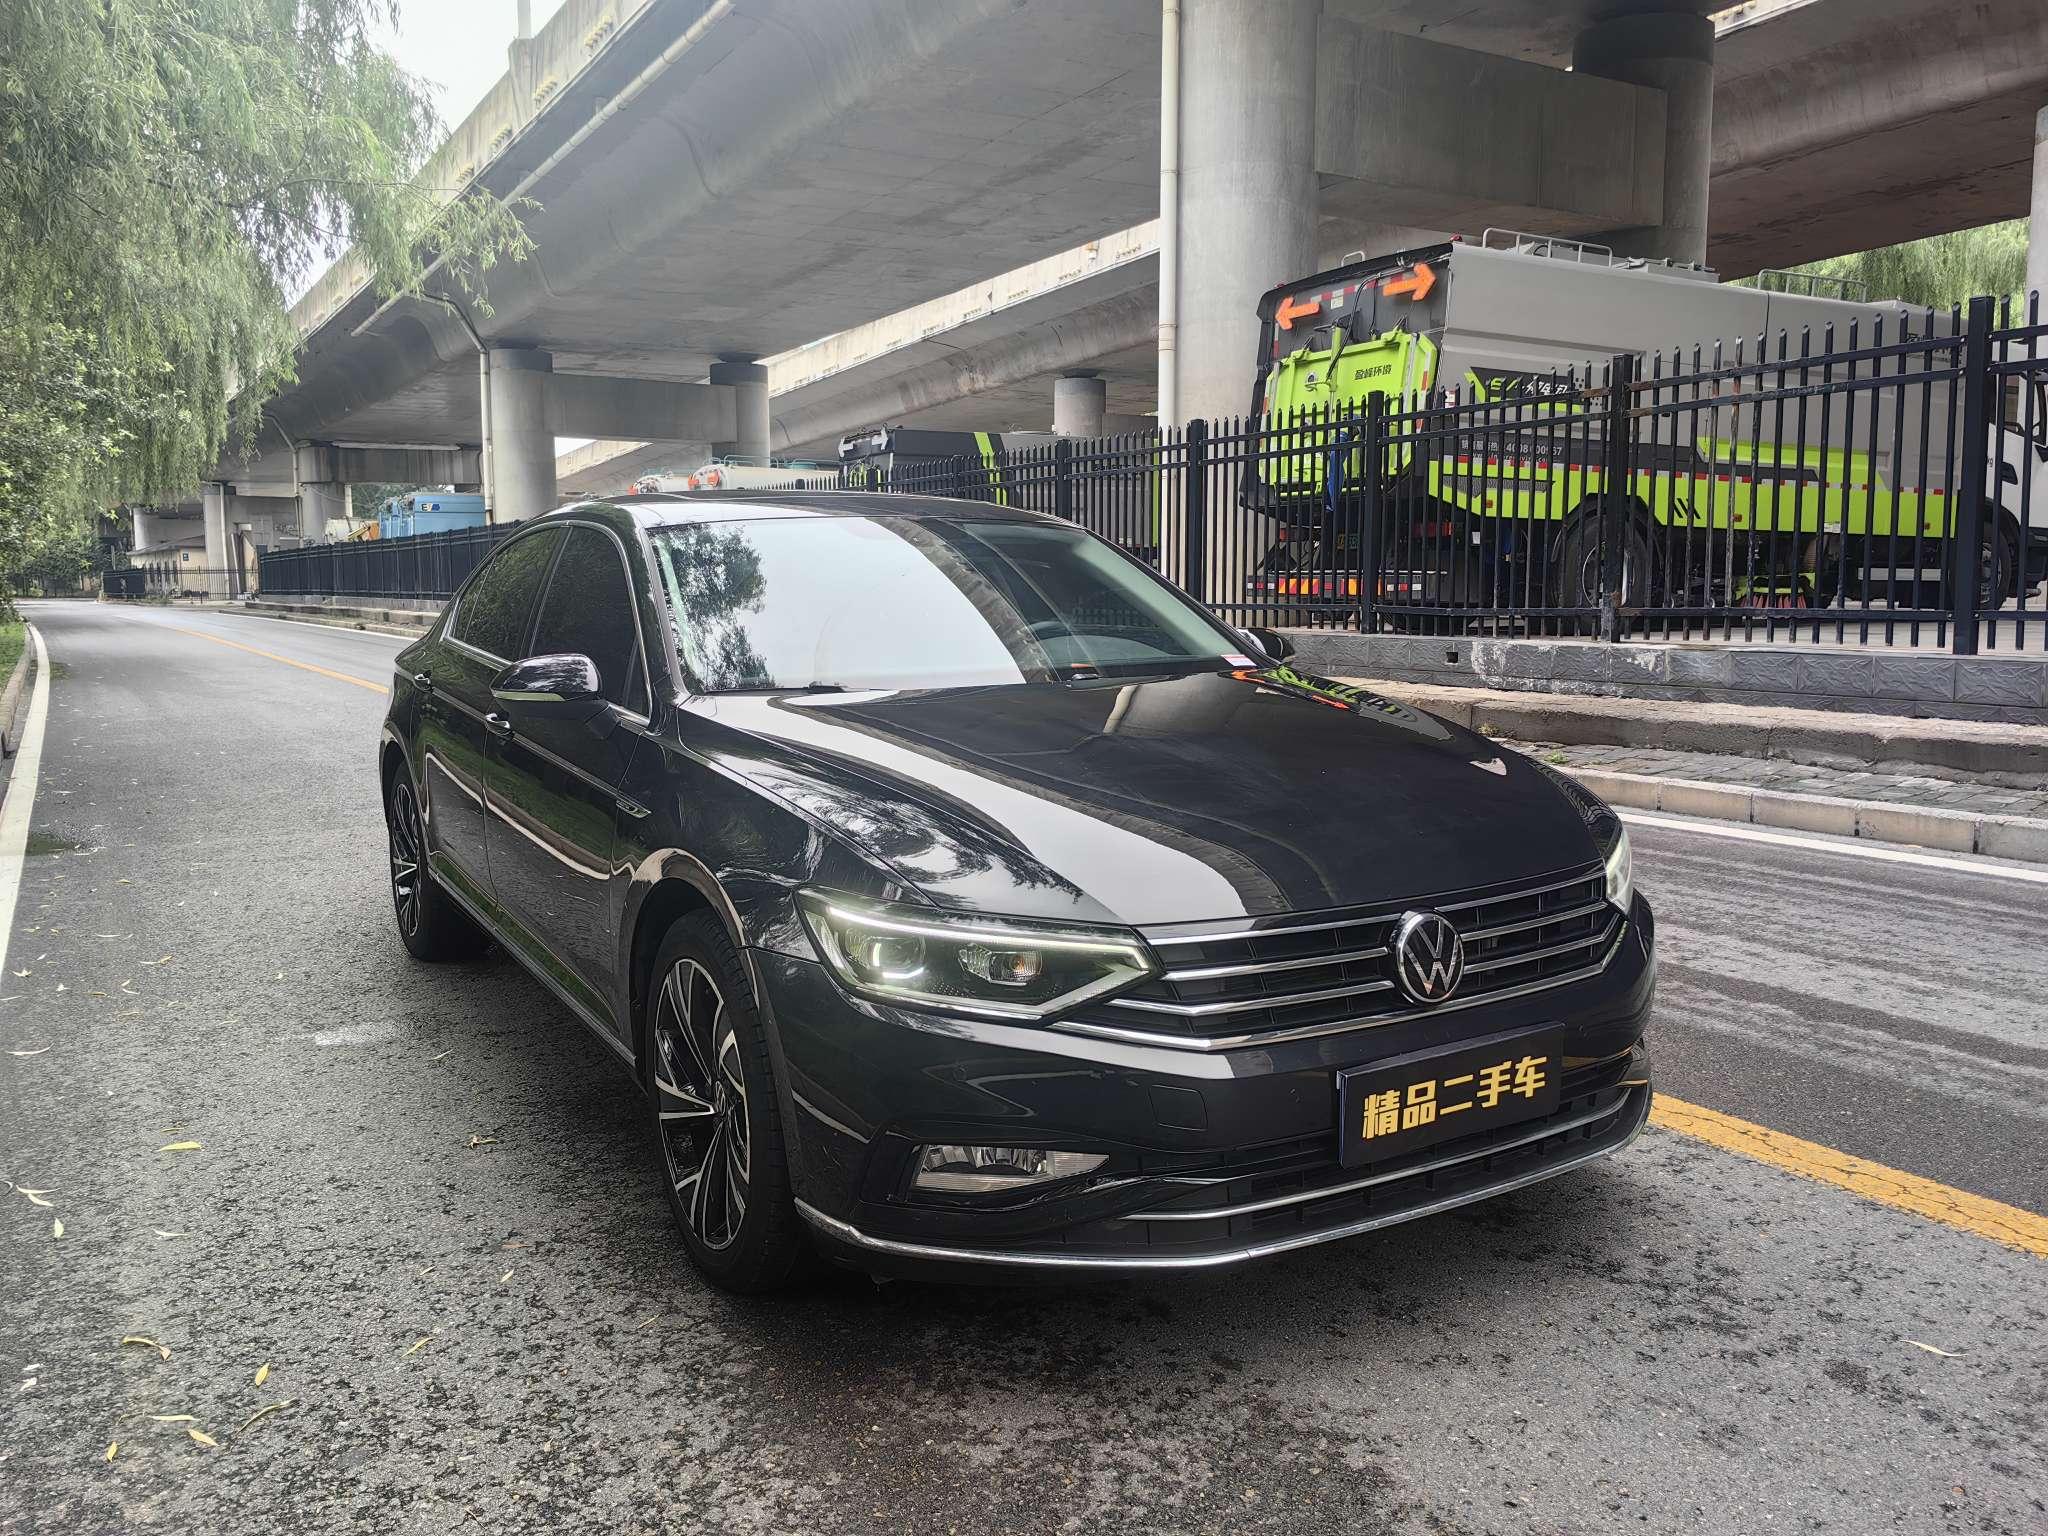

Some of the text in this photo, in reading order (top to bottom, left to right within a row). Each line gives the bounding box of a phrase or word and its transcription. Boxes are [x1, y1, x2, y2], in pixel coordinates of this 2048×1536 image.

[1361, 1055, 1548, 1140] 精品二手车
